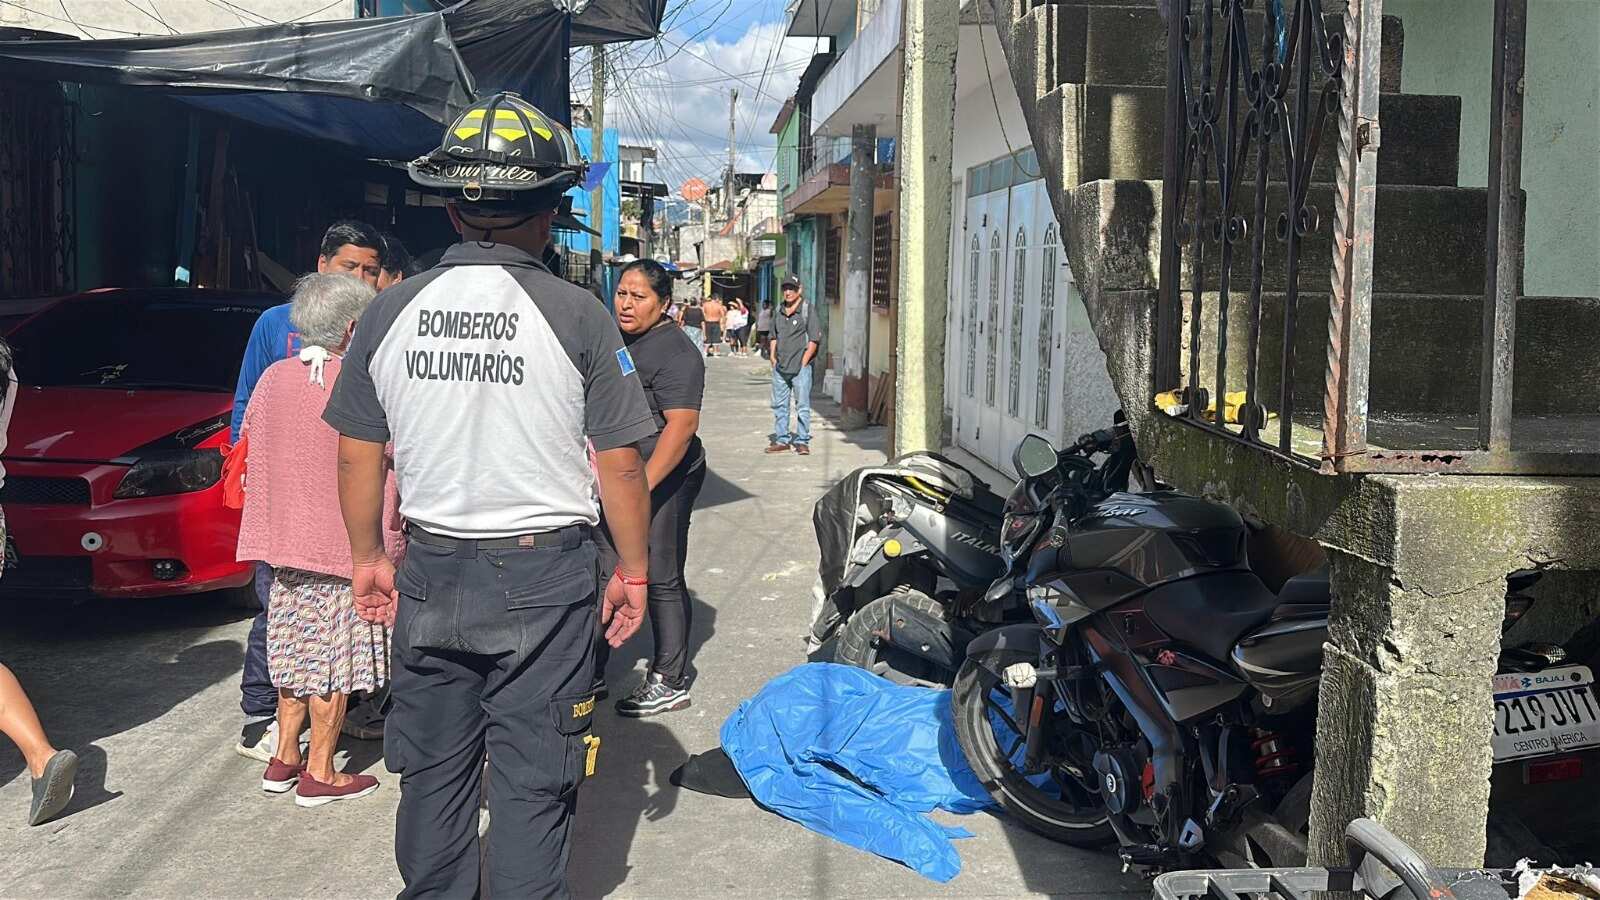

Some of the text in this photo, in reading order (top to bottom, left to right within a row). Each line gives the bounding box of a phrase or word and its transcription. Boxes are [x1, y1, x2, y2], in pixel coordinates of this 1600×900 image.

[417, 309, 519, 340] BOMBEROS
[1535, 674, 1565, 684] BAJAJ
[1513, 737, 1549, 752] CENTRO
